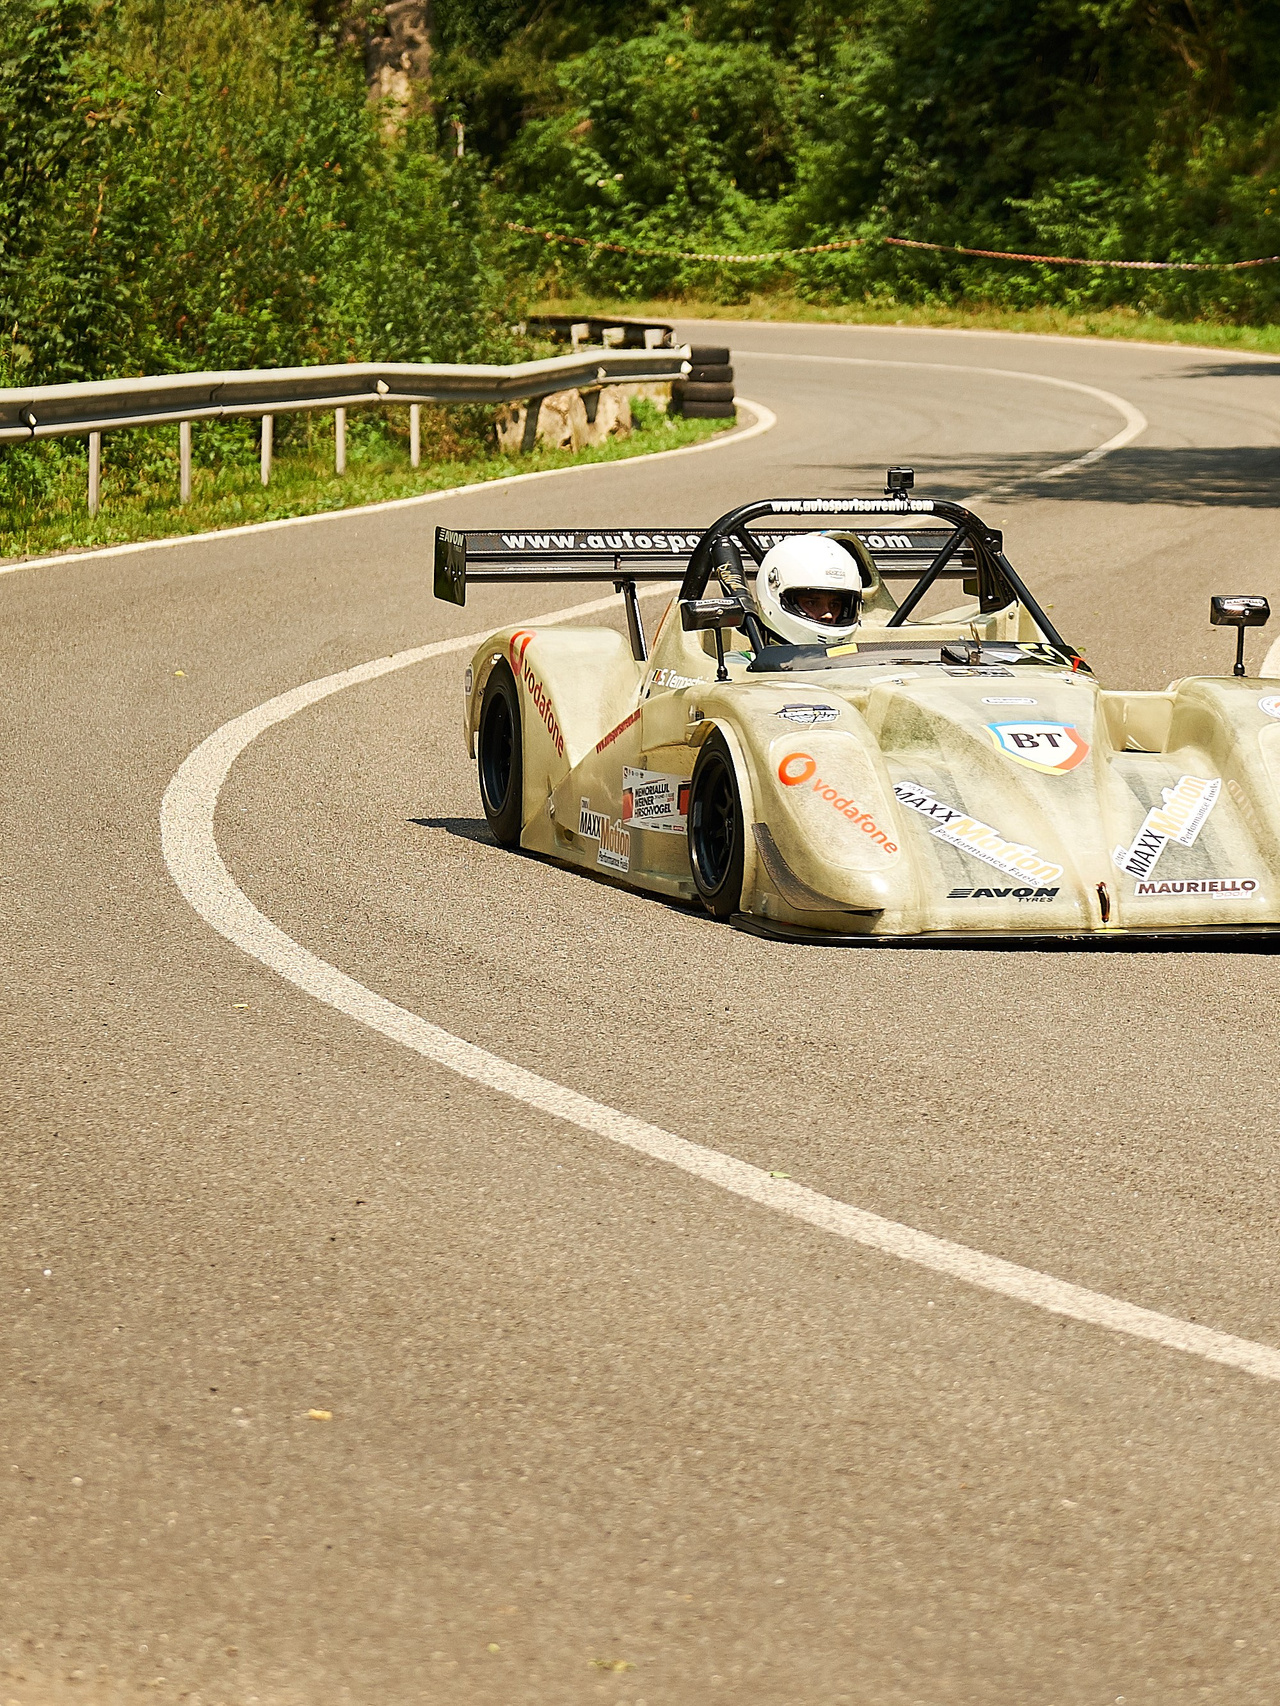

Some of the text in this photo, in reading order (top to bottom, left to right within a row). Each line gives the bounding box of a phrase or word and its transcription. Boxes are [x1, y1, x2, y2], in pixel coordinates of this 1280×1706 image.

[443, 530, 465, 547] AVON
[523, 658, 564, 758] vodafone
[1007, 732, 1062, 748] BT
[580, 811, 630, 858] MAXX Motion
[812, 778, 898, 854] vodafone
[894, 786, 1060, 881] MAXX Motion
[1125, 777, 1207, 878] MAXX Motion
[1179, 802, 1210, 844] Performance
[935, 828, 1040, 887] Performance Fuels
[971, 887, 1060, 898] AVON
[1138, 880, 1256, 895] MAURIELLO
